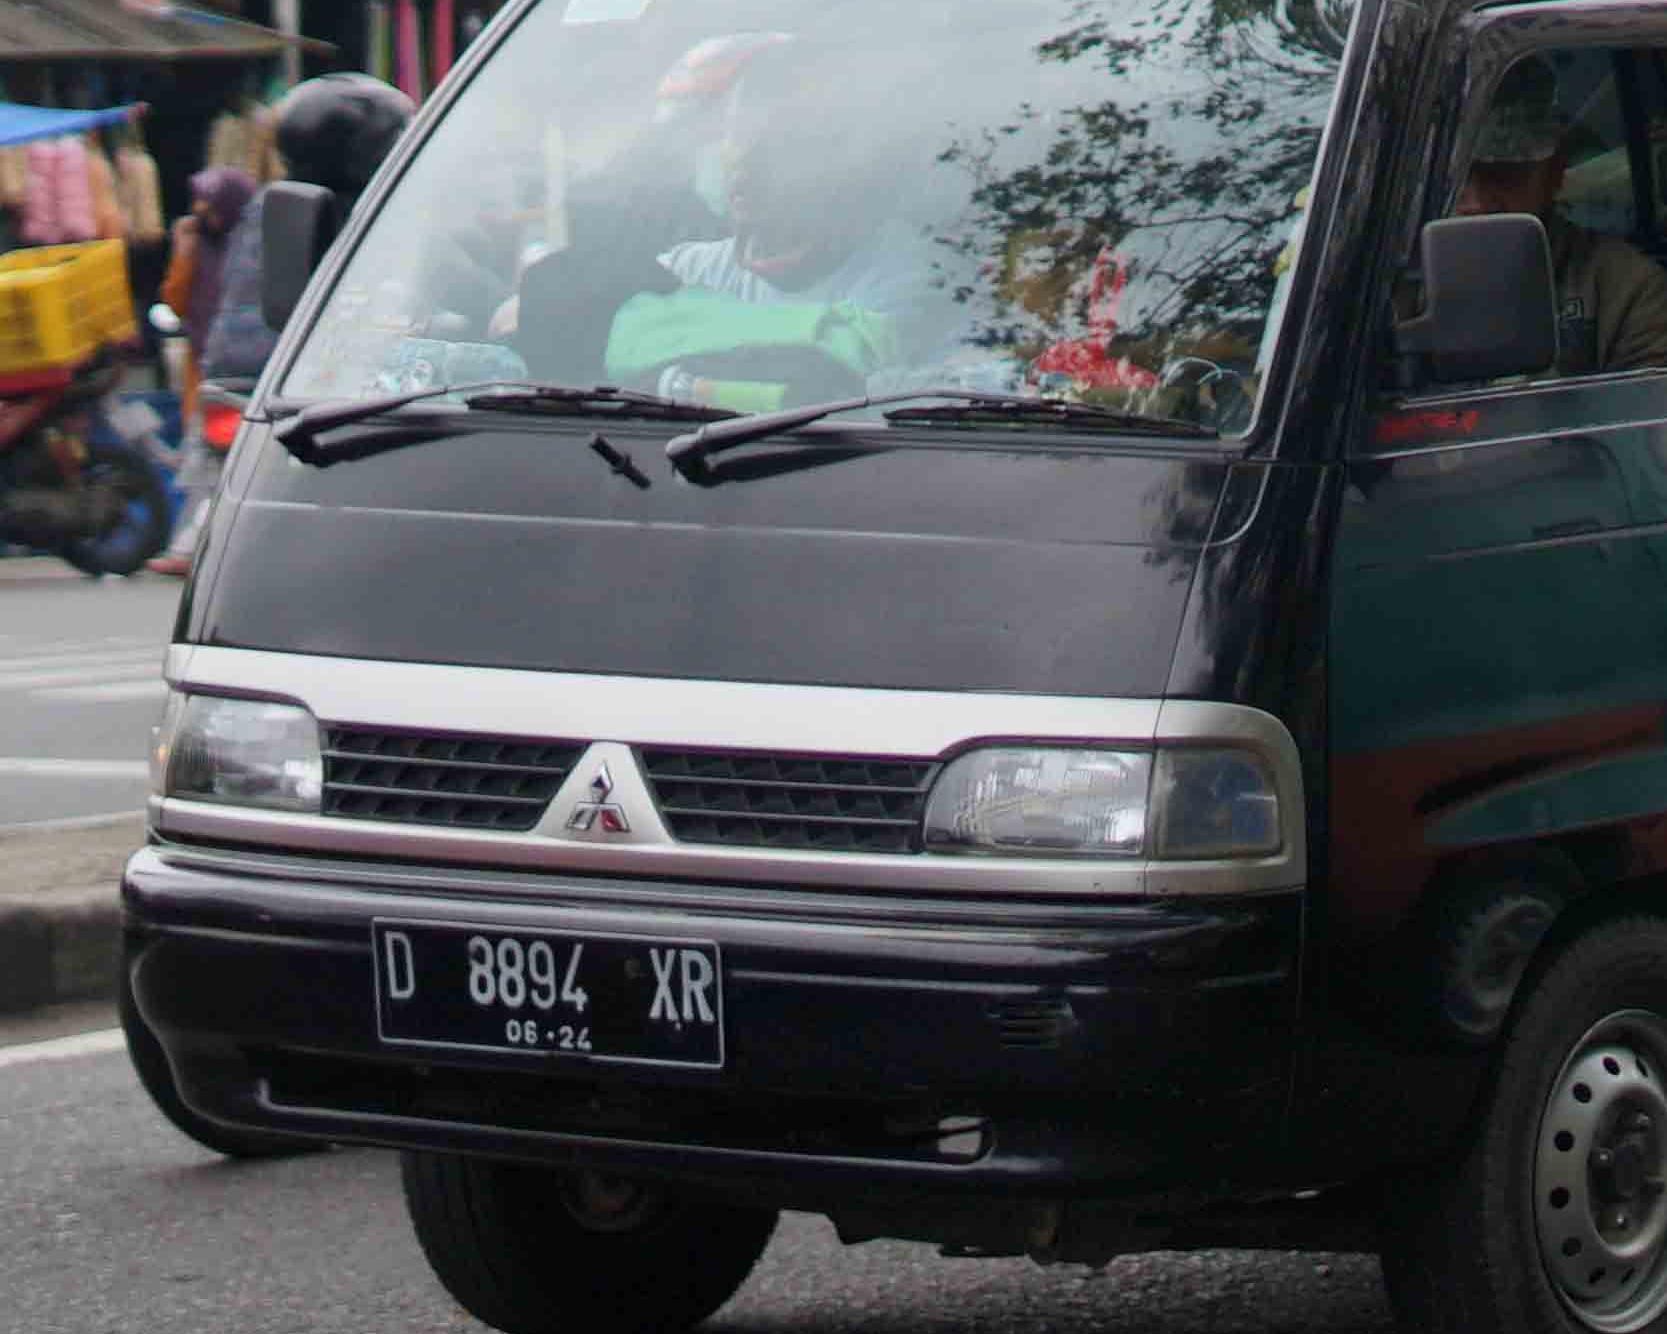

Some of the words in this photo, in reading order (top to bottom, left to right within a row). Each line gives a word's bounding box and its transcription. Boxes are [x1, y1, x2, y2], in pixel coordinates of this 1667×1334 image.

[384, 930, 416, 1000] D
[467, 935, 588, 1012] 8894
[649, 947, 716, 1022] XR
